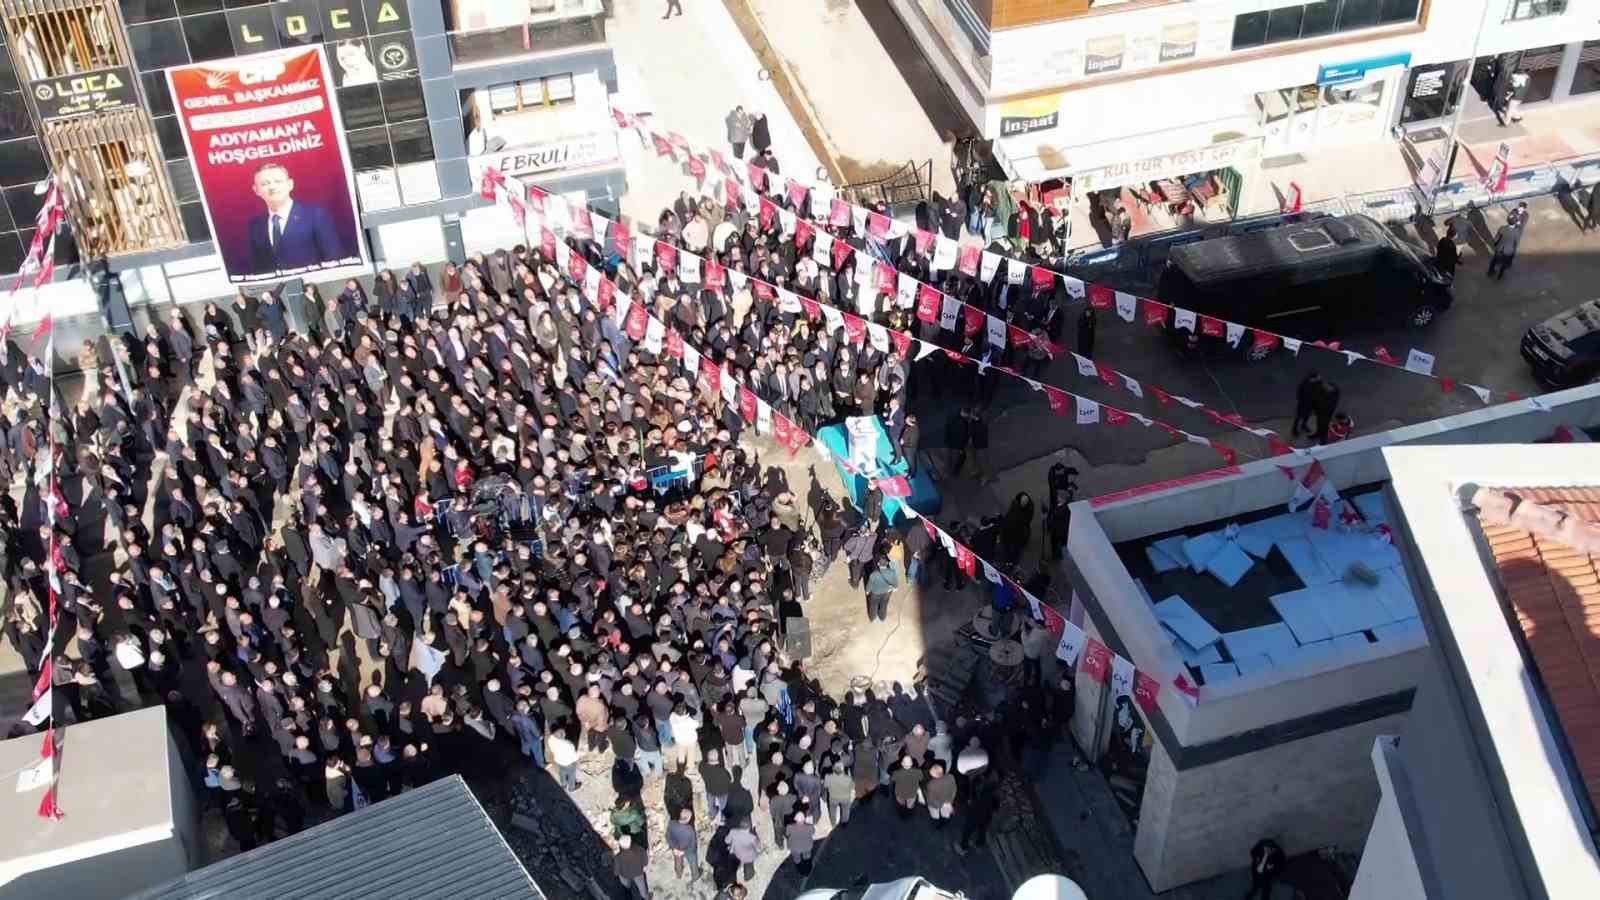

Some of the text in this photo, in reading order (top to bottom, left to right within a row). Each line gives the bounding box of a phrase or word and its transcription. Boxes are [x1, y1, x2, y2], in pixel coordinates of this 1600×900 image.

[241, 2, 400, 43] LOCA
[55, 73, 123, 97] LOCA
[184, 78, 320, 110] GENEL BAŞKANIMIZ
[210, 119, 316, 148] ADIYAMAN'A
[208, 132, 323, 165] HOŞGELDİNİZ
[943, 312, 956, 320] CHP
[1080, 408, 1095, 416] CHP
